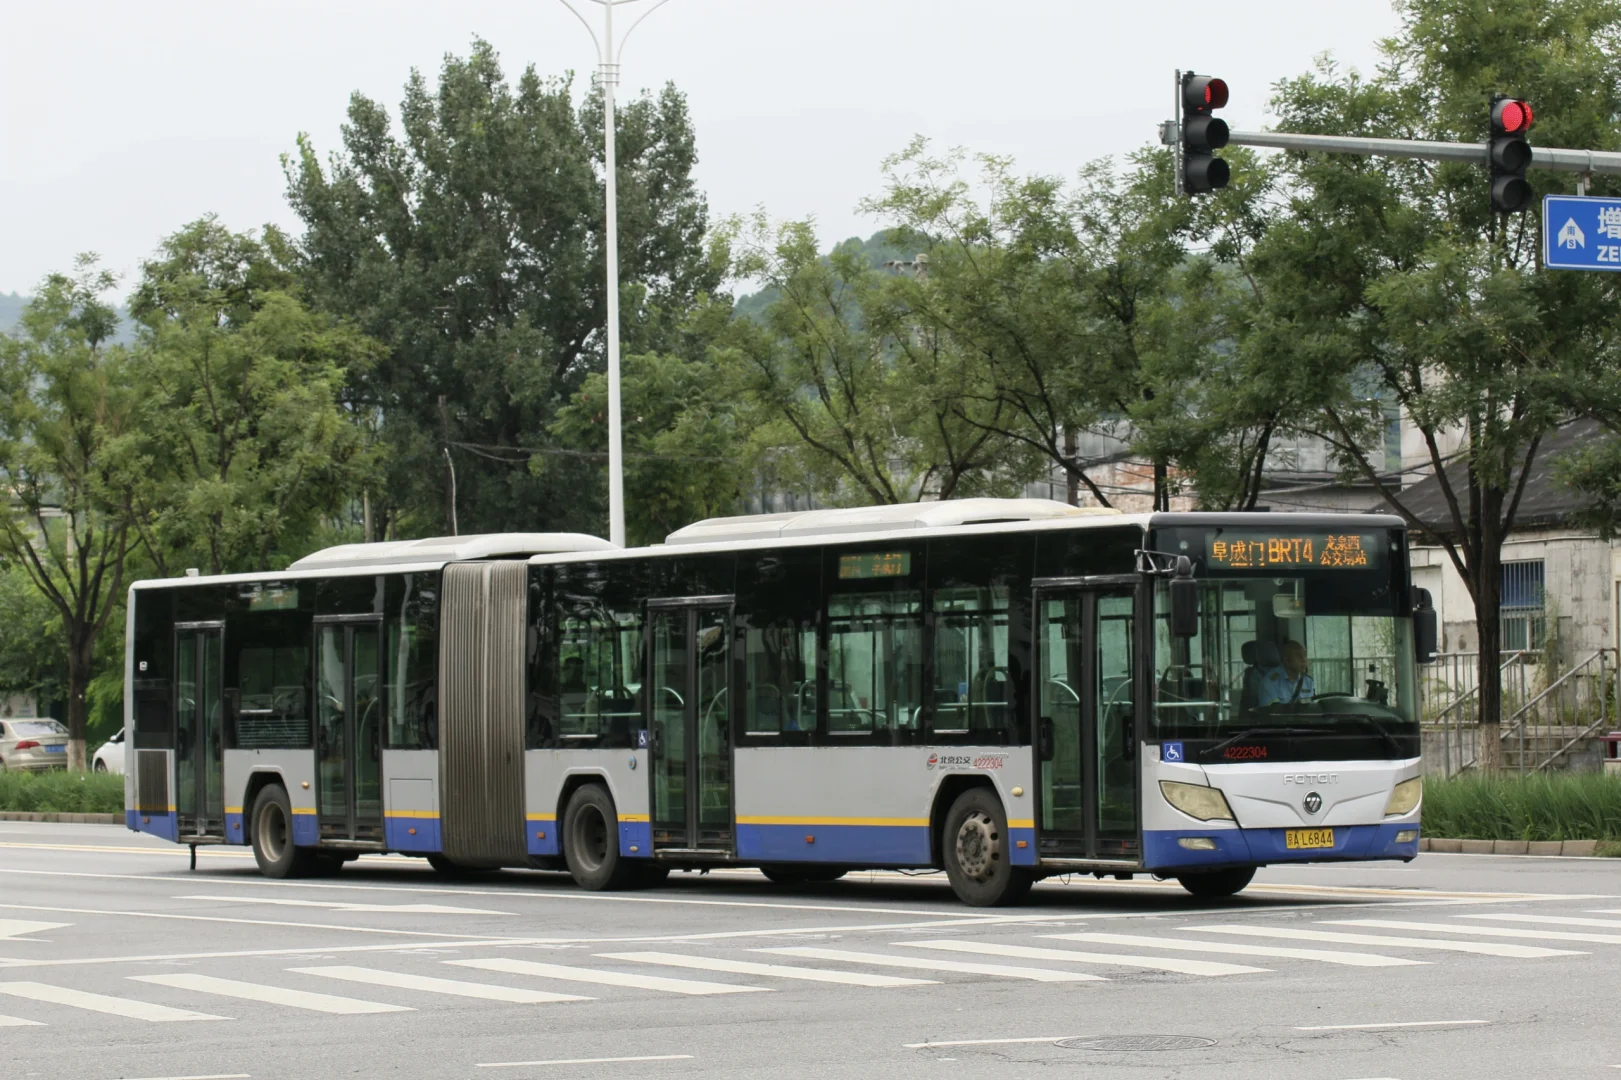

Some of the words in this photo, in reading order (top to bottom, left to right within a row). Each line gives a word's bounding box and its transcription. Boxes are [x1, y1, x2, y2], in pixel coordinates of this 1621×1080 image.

[1568, 240, 1574, 248] S
[1597, 245, 1621, 262] ZE
[1325, 535, 1360, 551] 龙泉西
[1212, 541, 1265, 566] 阜成门
[1268, 538, 1314, 563] BRT4
[1320, 550, 1367, 566] 公交场站
[1224, 747, 1267, 759] 4222304
[940, 756, 971, 764] 北京公交
[973, 757, 1003, 769] 4222304
[1284, 773, 1339, 785] FOTON
